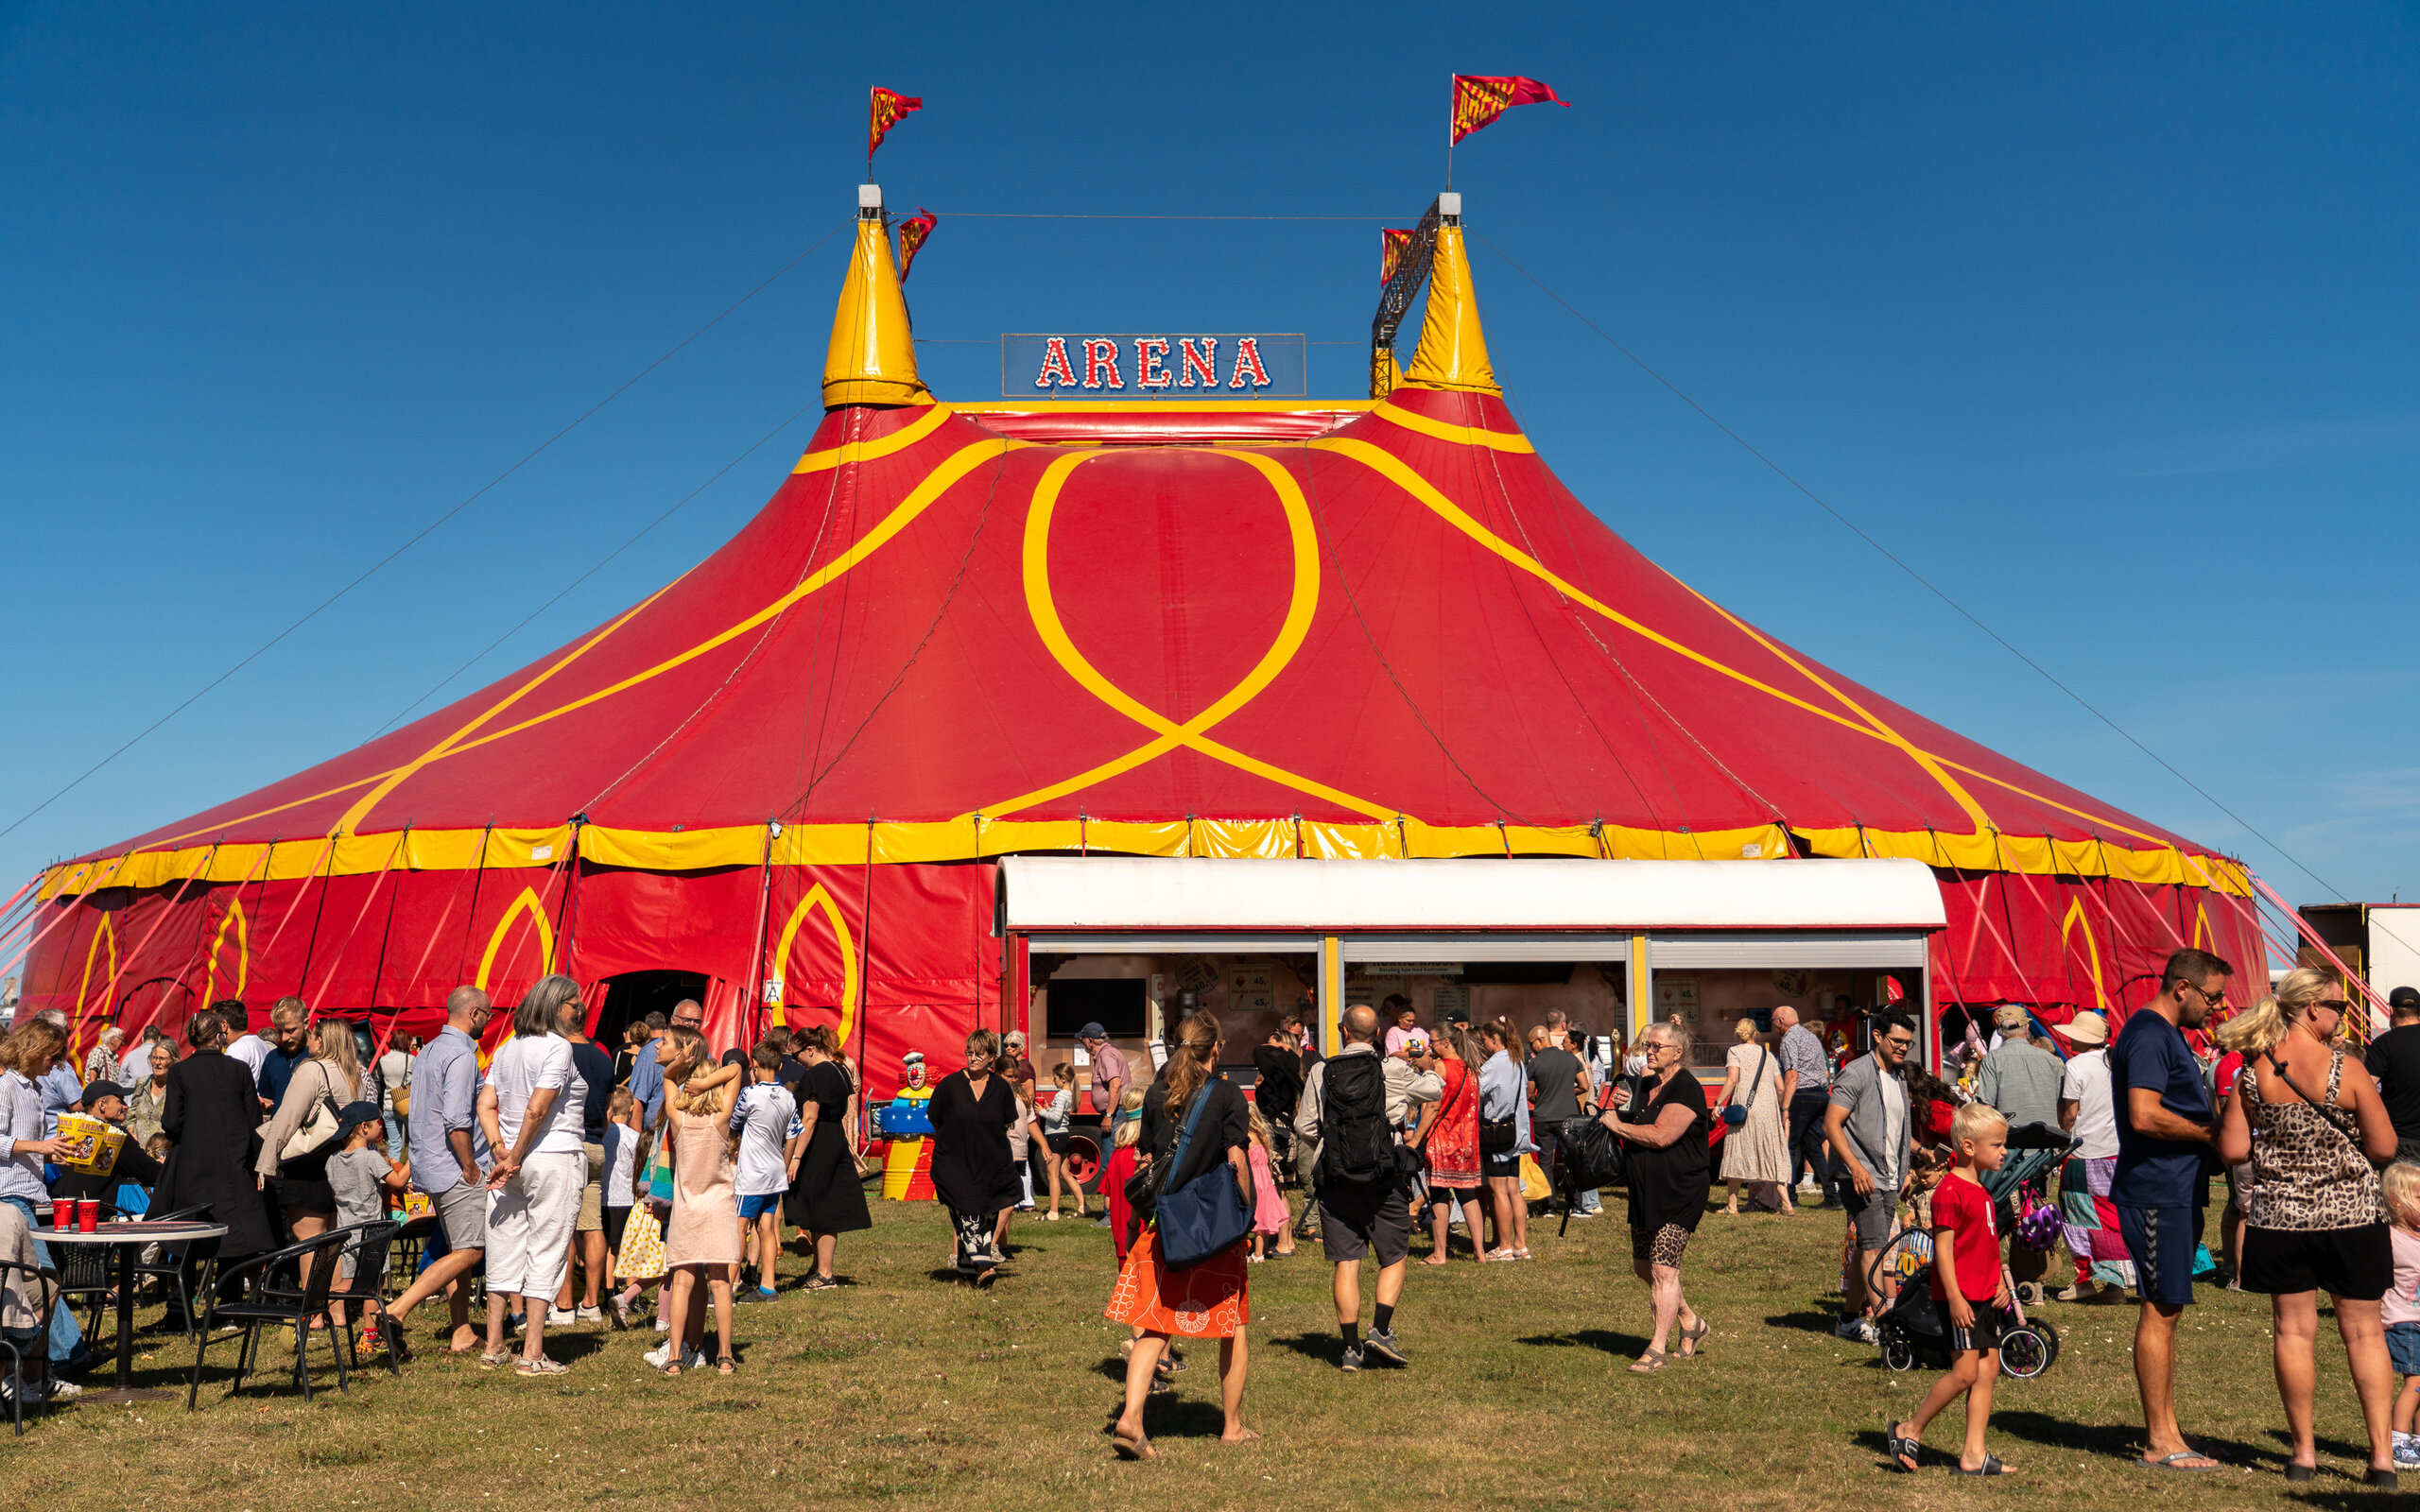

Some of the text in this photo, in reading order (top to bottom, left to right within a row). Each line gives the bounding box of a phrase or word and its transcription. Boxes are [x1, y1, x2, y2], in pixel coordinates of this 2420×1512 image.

[1035, 336, 1272, 389] ARENA
[1254, 976, 1270, 986] 45,-
[1254, 998, 1270, 1006] 45,-
[1986, 1201, 1995, 1236] 4
[1896, 1251, 1916, 1276] 70
